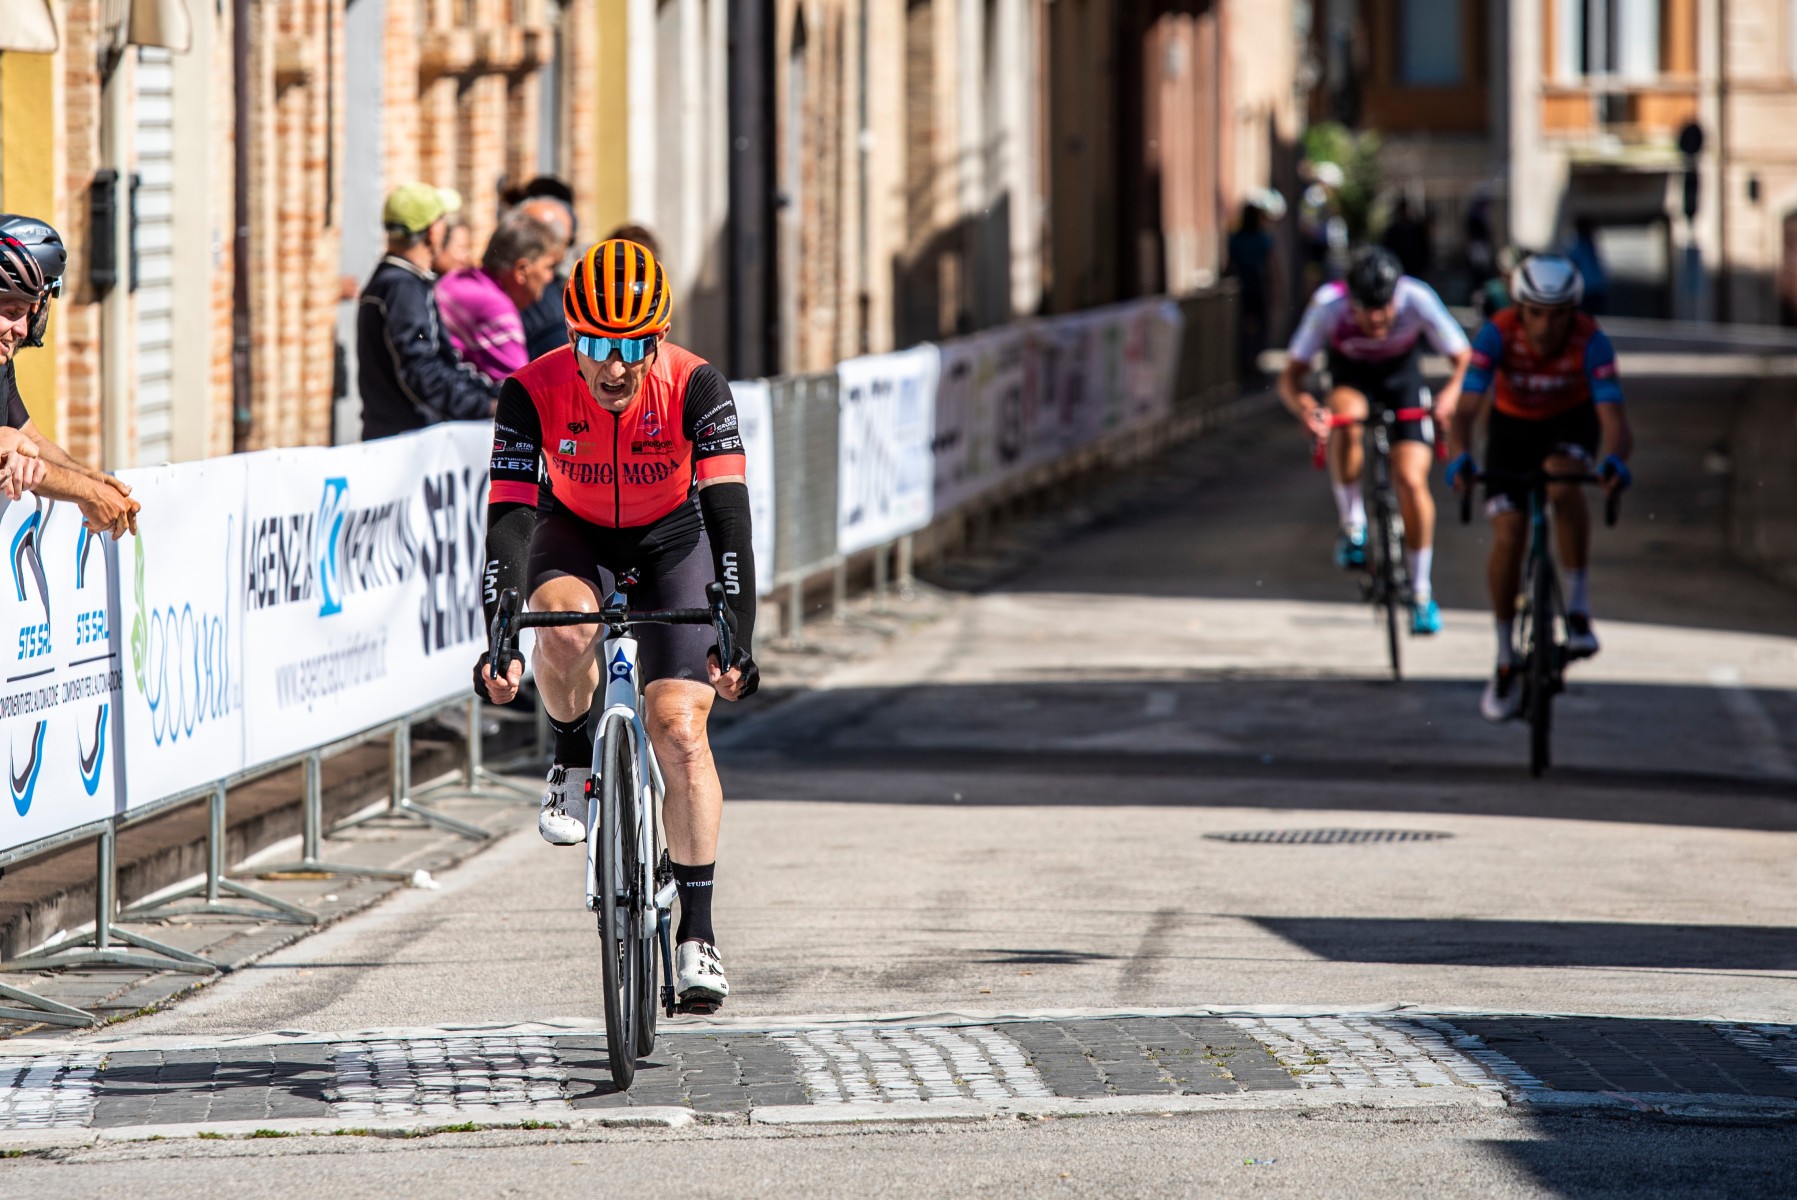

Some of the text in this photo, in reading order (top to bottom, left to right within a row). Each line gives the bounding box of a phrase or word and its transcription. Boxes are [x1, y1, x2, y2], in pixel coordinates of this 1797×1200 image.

[552, 456, 680, 485] STUDIO MODA
[17, 622, 52, 660] STS SRL
[77, 610, 109, 645] STS SRL
[612, 661, 628, 675] G
[686, 880, 712, 888] STUDIO
